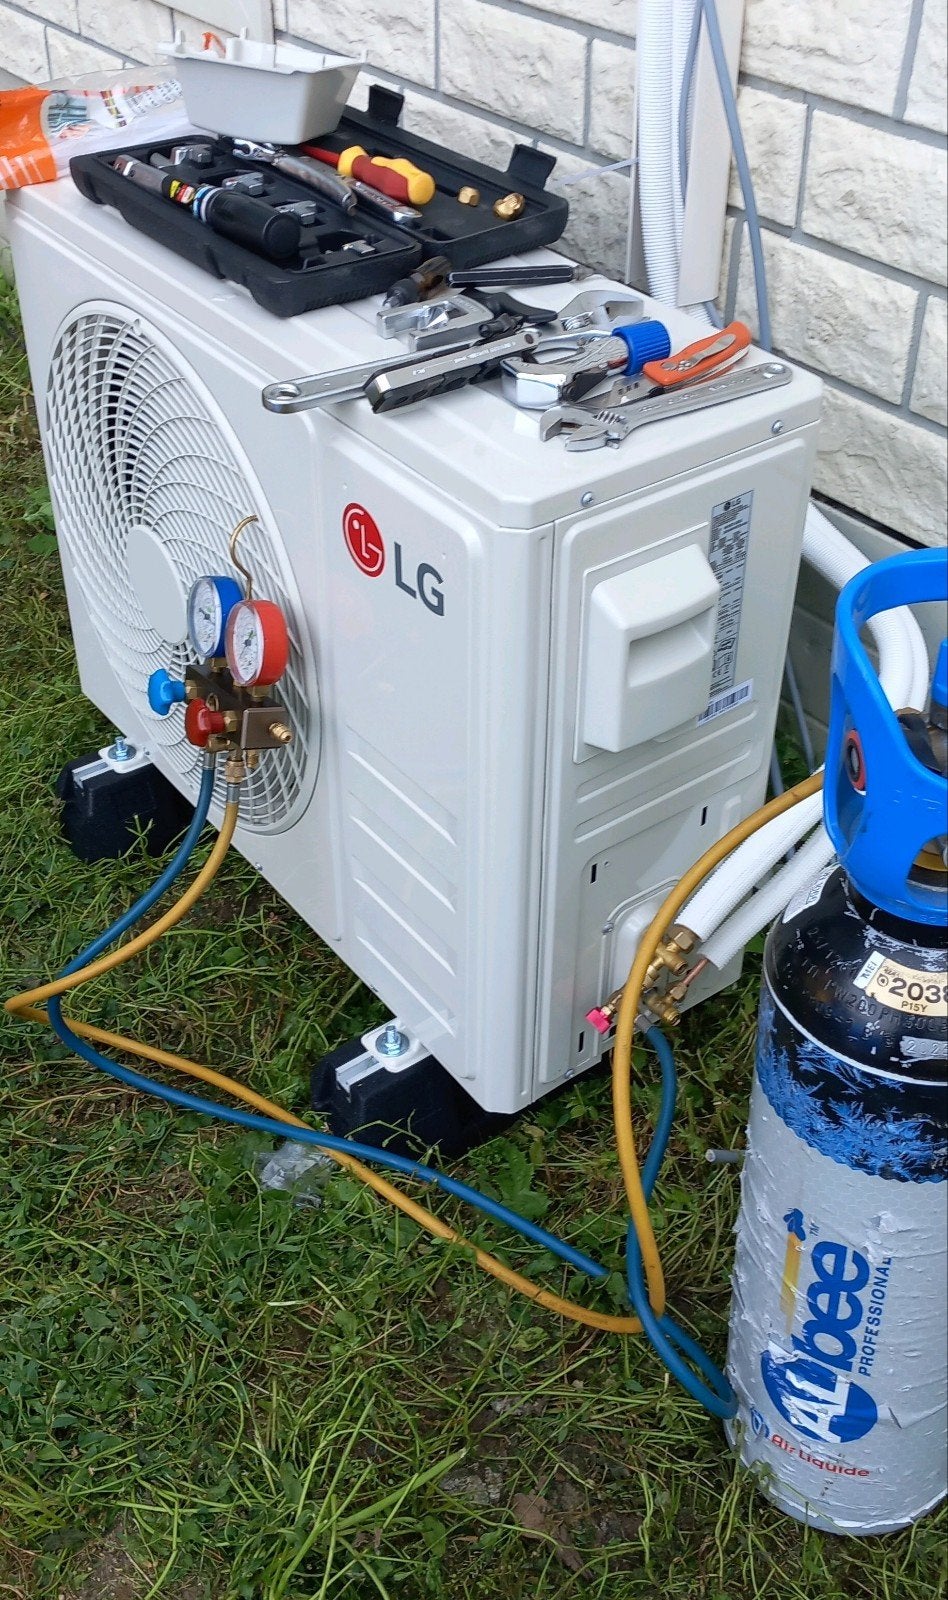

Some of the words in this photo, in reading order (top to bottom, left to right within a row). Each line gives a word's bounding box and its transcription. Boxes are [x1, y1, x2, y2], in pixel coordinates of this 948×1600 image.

[394, 541, 445, 617] LG
[901, 1000, 928, 1013] P15Y
[771, 1434, 796, 1453] Air
